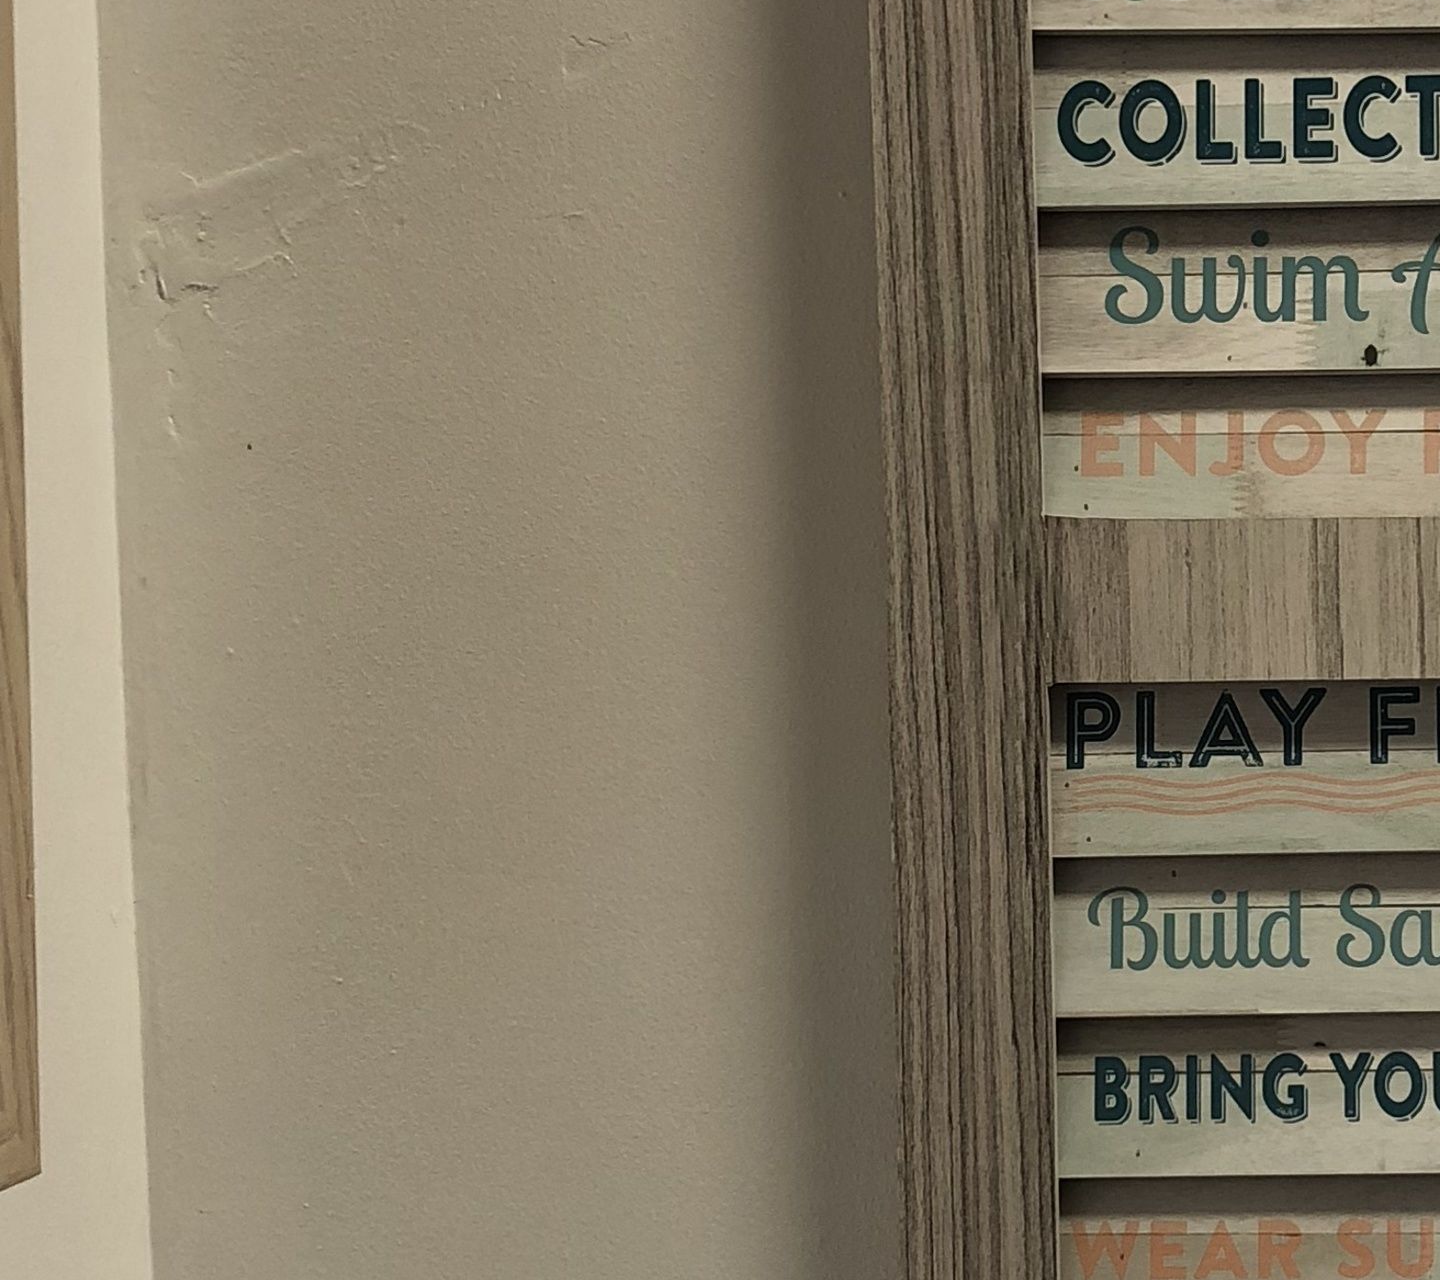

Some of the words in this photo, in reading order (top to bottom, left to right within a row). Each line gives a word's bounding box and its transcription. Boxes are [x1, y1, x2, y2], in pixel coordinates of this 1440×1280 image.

[1104, 225, 1369, 325] Swim
[1079, 408, 1380, 478] ENJOY
[1065, 686, 1328, 770] PLAY
[1087, 885, 1309, 970] Build
[1092, 1053, 1310, 1126] BRING
[1071, 1219, 1305, 1280] WEAR
